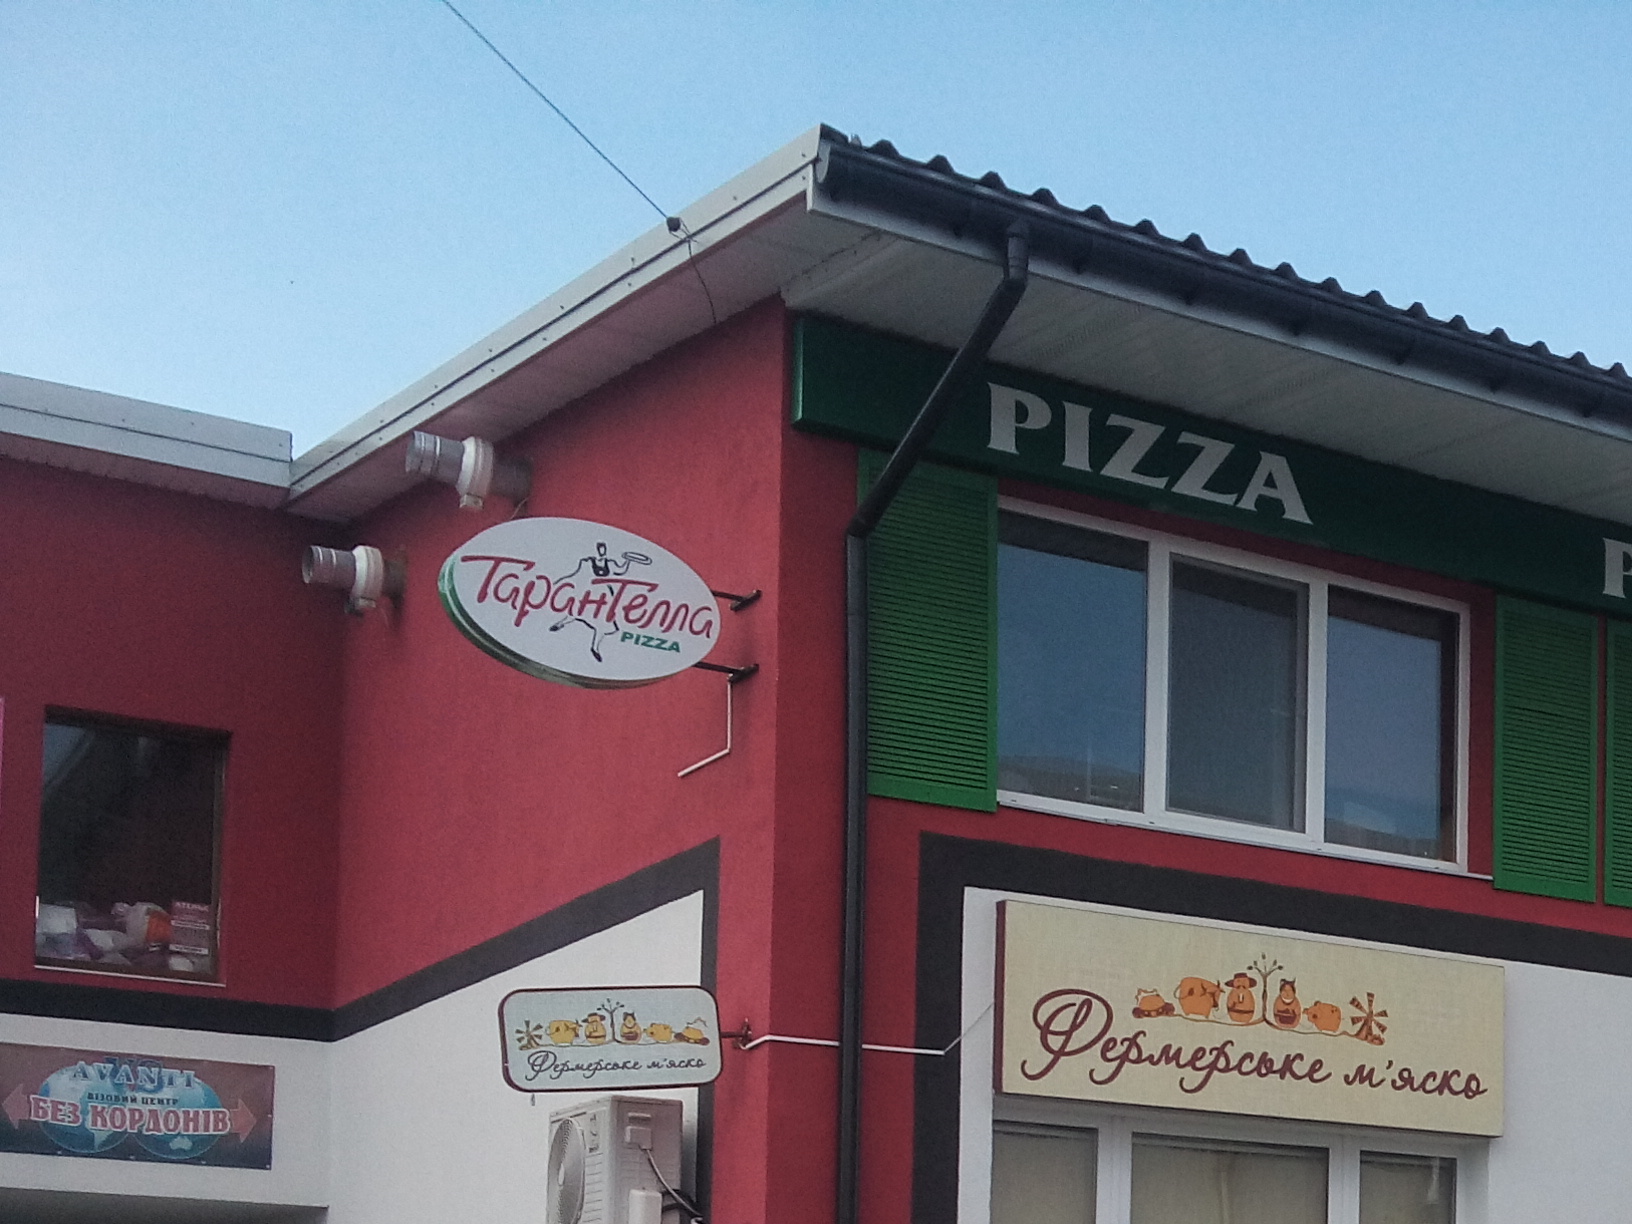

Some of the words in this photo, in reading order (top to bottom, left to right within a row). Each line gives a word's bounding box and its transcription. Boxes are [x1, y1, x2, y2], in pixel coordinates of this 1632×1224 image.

[986, 382, 1313, 525] PIZZA
[620, 631, 681, 653] PIZZA
[1020, 989, 1333, 1094] Фермерське
[1344, 1060, 1489, 1100] м'яско
[71, 1060, 198, 1089] AVANTI
[525, 1050, 642, 1081] Фермерське
[30, 1095, 82, 1127] БЕЗ
[89, 1102, 231, 1135] КОРДОНІВ
[141, 1096, 179, 1106] ЦЕНТР
